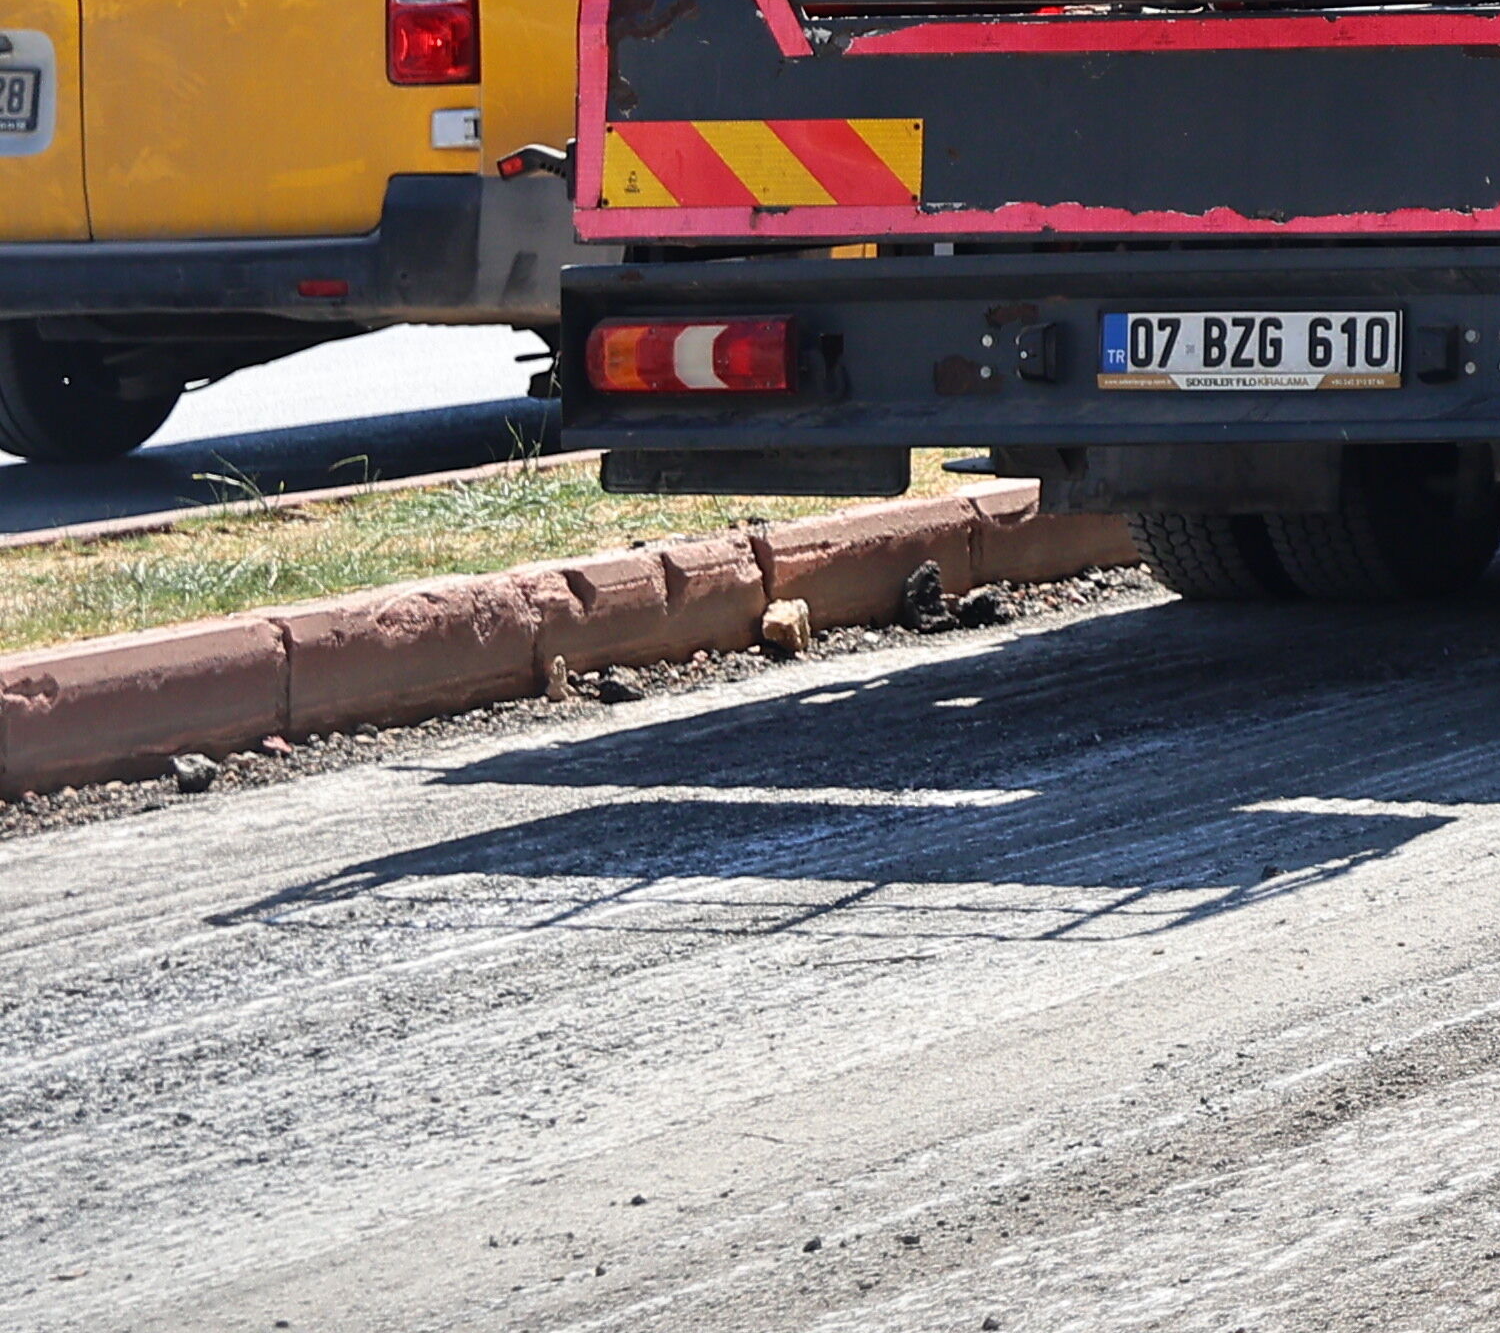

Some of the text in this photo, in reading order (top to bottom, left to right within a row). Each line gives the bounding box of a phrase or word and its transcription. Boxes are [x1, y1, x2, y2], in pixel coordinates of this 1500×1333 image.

[1107, 348, 1126, 365] TR
[1130, 317, 1390, 368] 07 BZG 610
